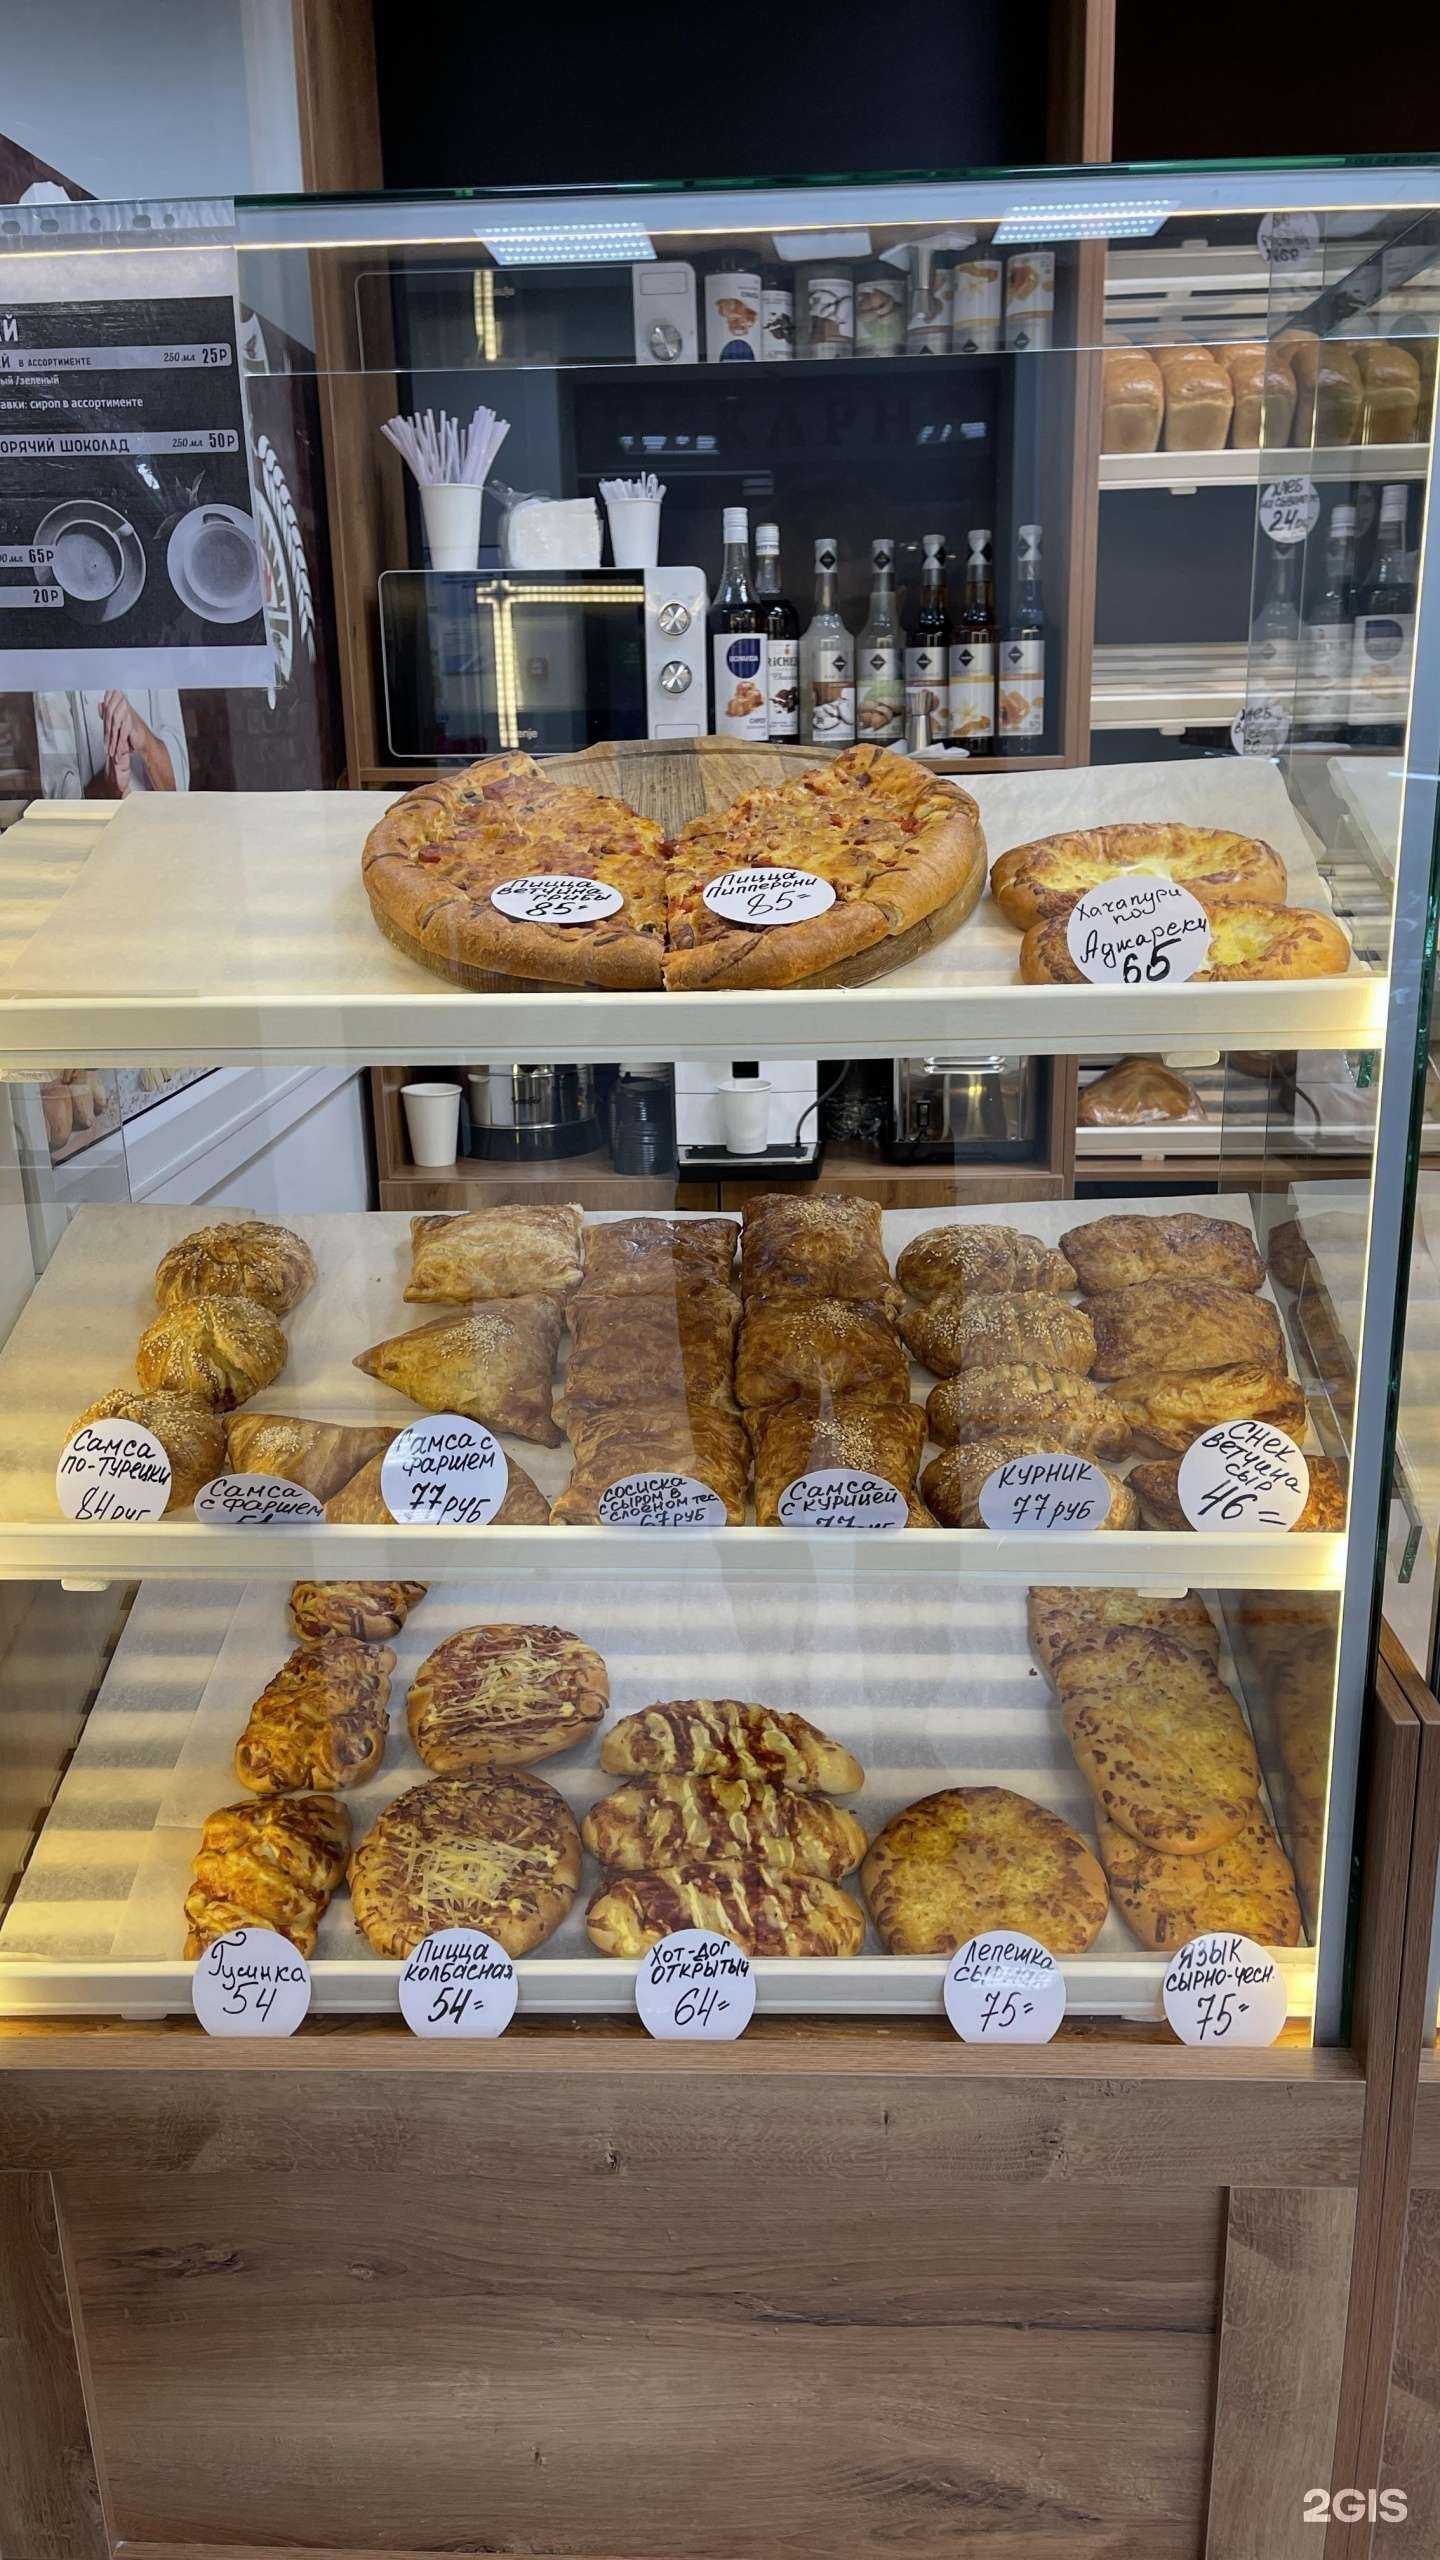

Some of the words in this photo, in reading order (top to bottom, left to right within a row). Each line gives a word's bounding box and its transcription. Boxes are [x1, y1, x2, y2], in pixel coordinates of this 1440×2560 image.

[18, 358, 25, 368] В
[28, 357, 92, 367] АССОРТИМЕНТЕ
[163, 352, 180, 362] 250
[30, 400, 60, 411] сироп
[71, 399, 144, 411] ассортименте
[60, 439, 130, 453] ШОКОЛАД
[172, 438, 188, 448] 250
[509, 879, 595, 889] Пицца
[705, 877, 819, 899] Пипперони
[719, 871, 799, 886] Пицца
[1122, 937, 1182, 984] 65
[73, 1429, 156, 1459] Самса
[480, 1435, 494, 1450] с
[1228, 1421, 1296, 1463] Снек
[998, 1462, 1093, 1489] КУРНИК
[1225, 1463, 1273, 1491] сыр
[209, 1478, 302, 1498] Самса
[789, 1480, 883, 1501] Самса
[200, 1499, 215, 1510] с
[781, 1502, 796, 1516] с
[416, 1939, 490, 1964] Пицца
[964, 1940, 1055, 1970] Лепешка
[1178, 1939, 1243, 1969] ЯЗЫК
[222, 1981, 278, 2022] 54
